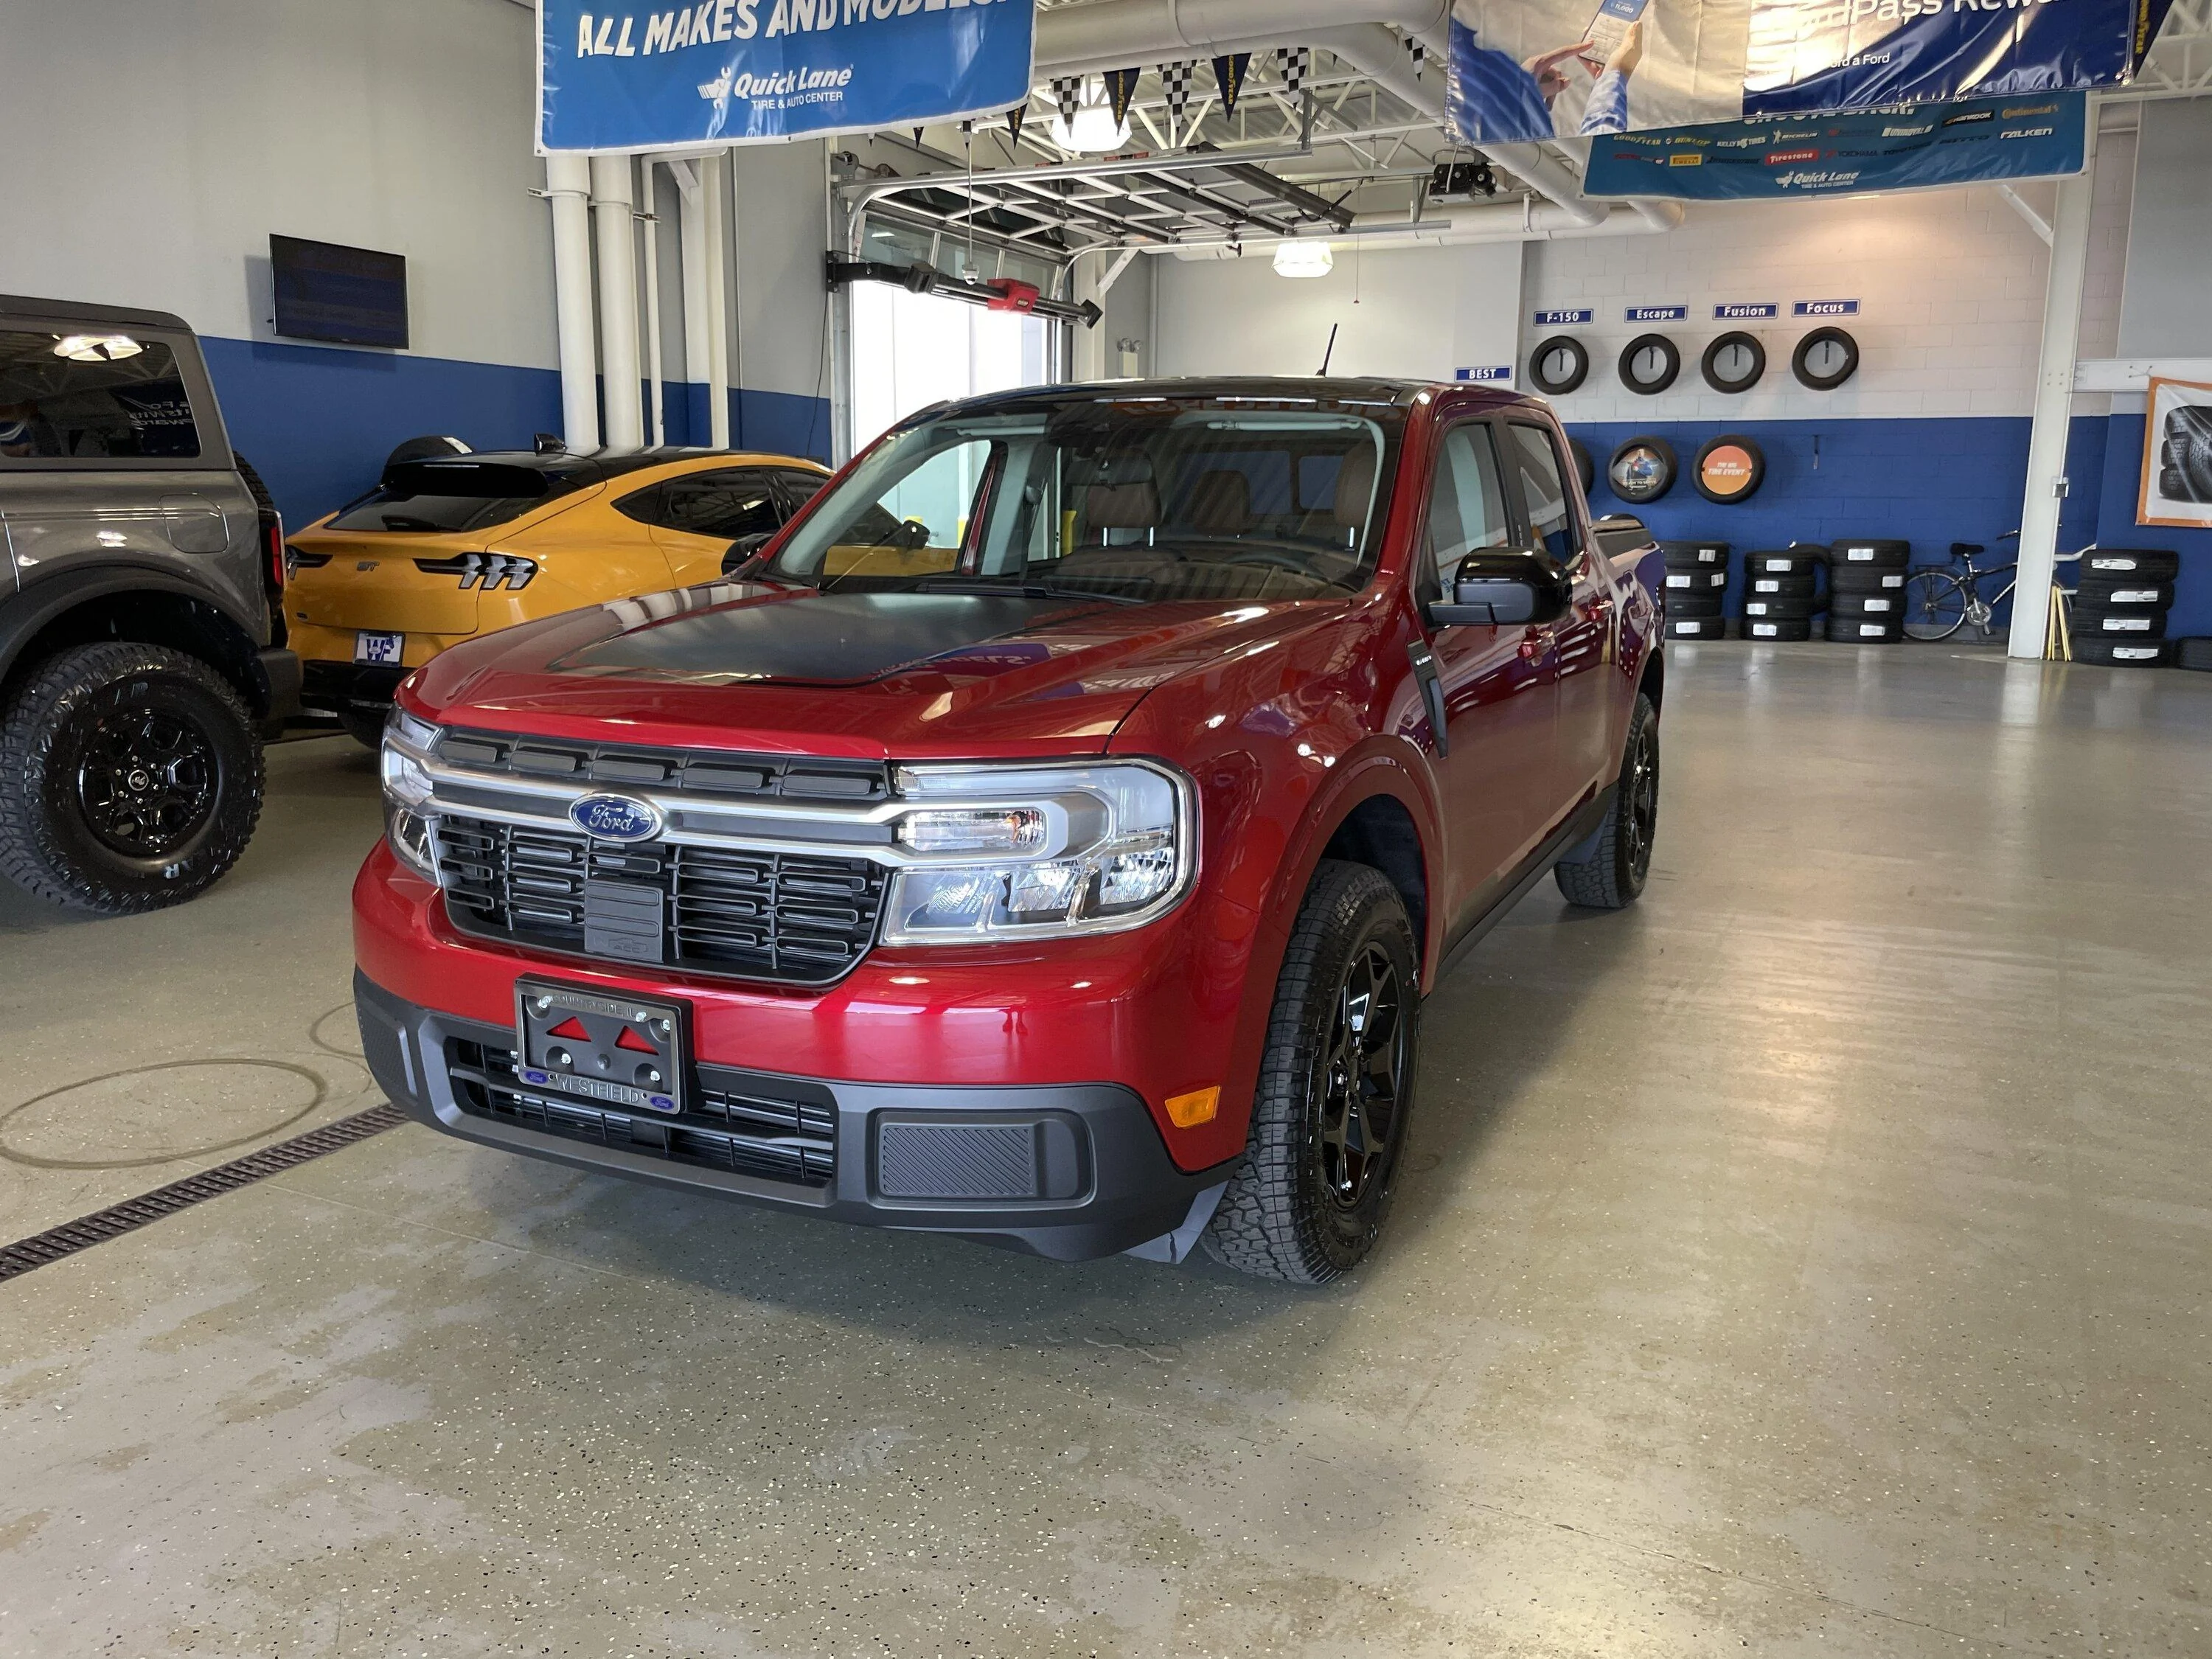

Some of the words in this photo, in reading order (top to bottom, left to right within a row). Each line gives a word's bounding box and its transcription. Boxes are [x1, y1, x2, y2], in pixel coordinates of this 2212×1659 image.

[577, 14, 636, 58] ALL
[642, 0, 759, 56] MAKES
[765, 0, 838, 38] AND
[1851, 58, 1860, 66] a
[1863, 52, 1891, 66] Ford
[734, 70, 797, 99] Quick
[798, 67, 852, 91] Lane
[751, 100, 775, 110] TIRE
[777, 100, 785, 109] &
[787, 96, 804, 108] AUTO
[805, 91, 843, 103] CENTER
[1781, 131, 1818, 140] MICHELIN
[2000, 127, 2053, 139] FALKEN
[1613, 134, 1661, 146] GOODYEAR
[1770, 153, 1814, 164] Firestone
[1793, 172, 1828, 184] Quick
[1828, 171, 1860, 181] Lane
[1724, 305, 1766, 317] Fusion
[1806, 303, 1844, 314] Focus
[1546, 312, 1579, 323] F-150
[1636, 309, 1674, 321] Escape
[1469, 369, 1496, 379] BEST
[589, 804, 636, 832] Ford
[555, 1074, 639, 1103] WESTFIELD
